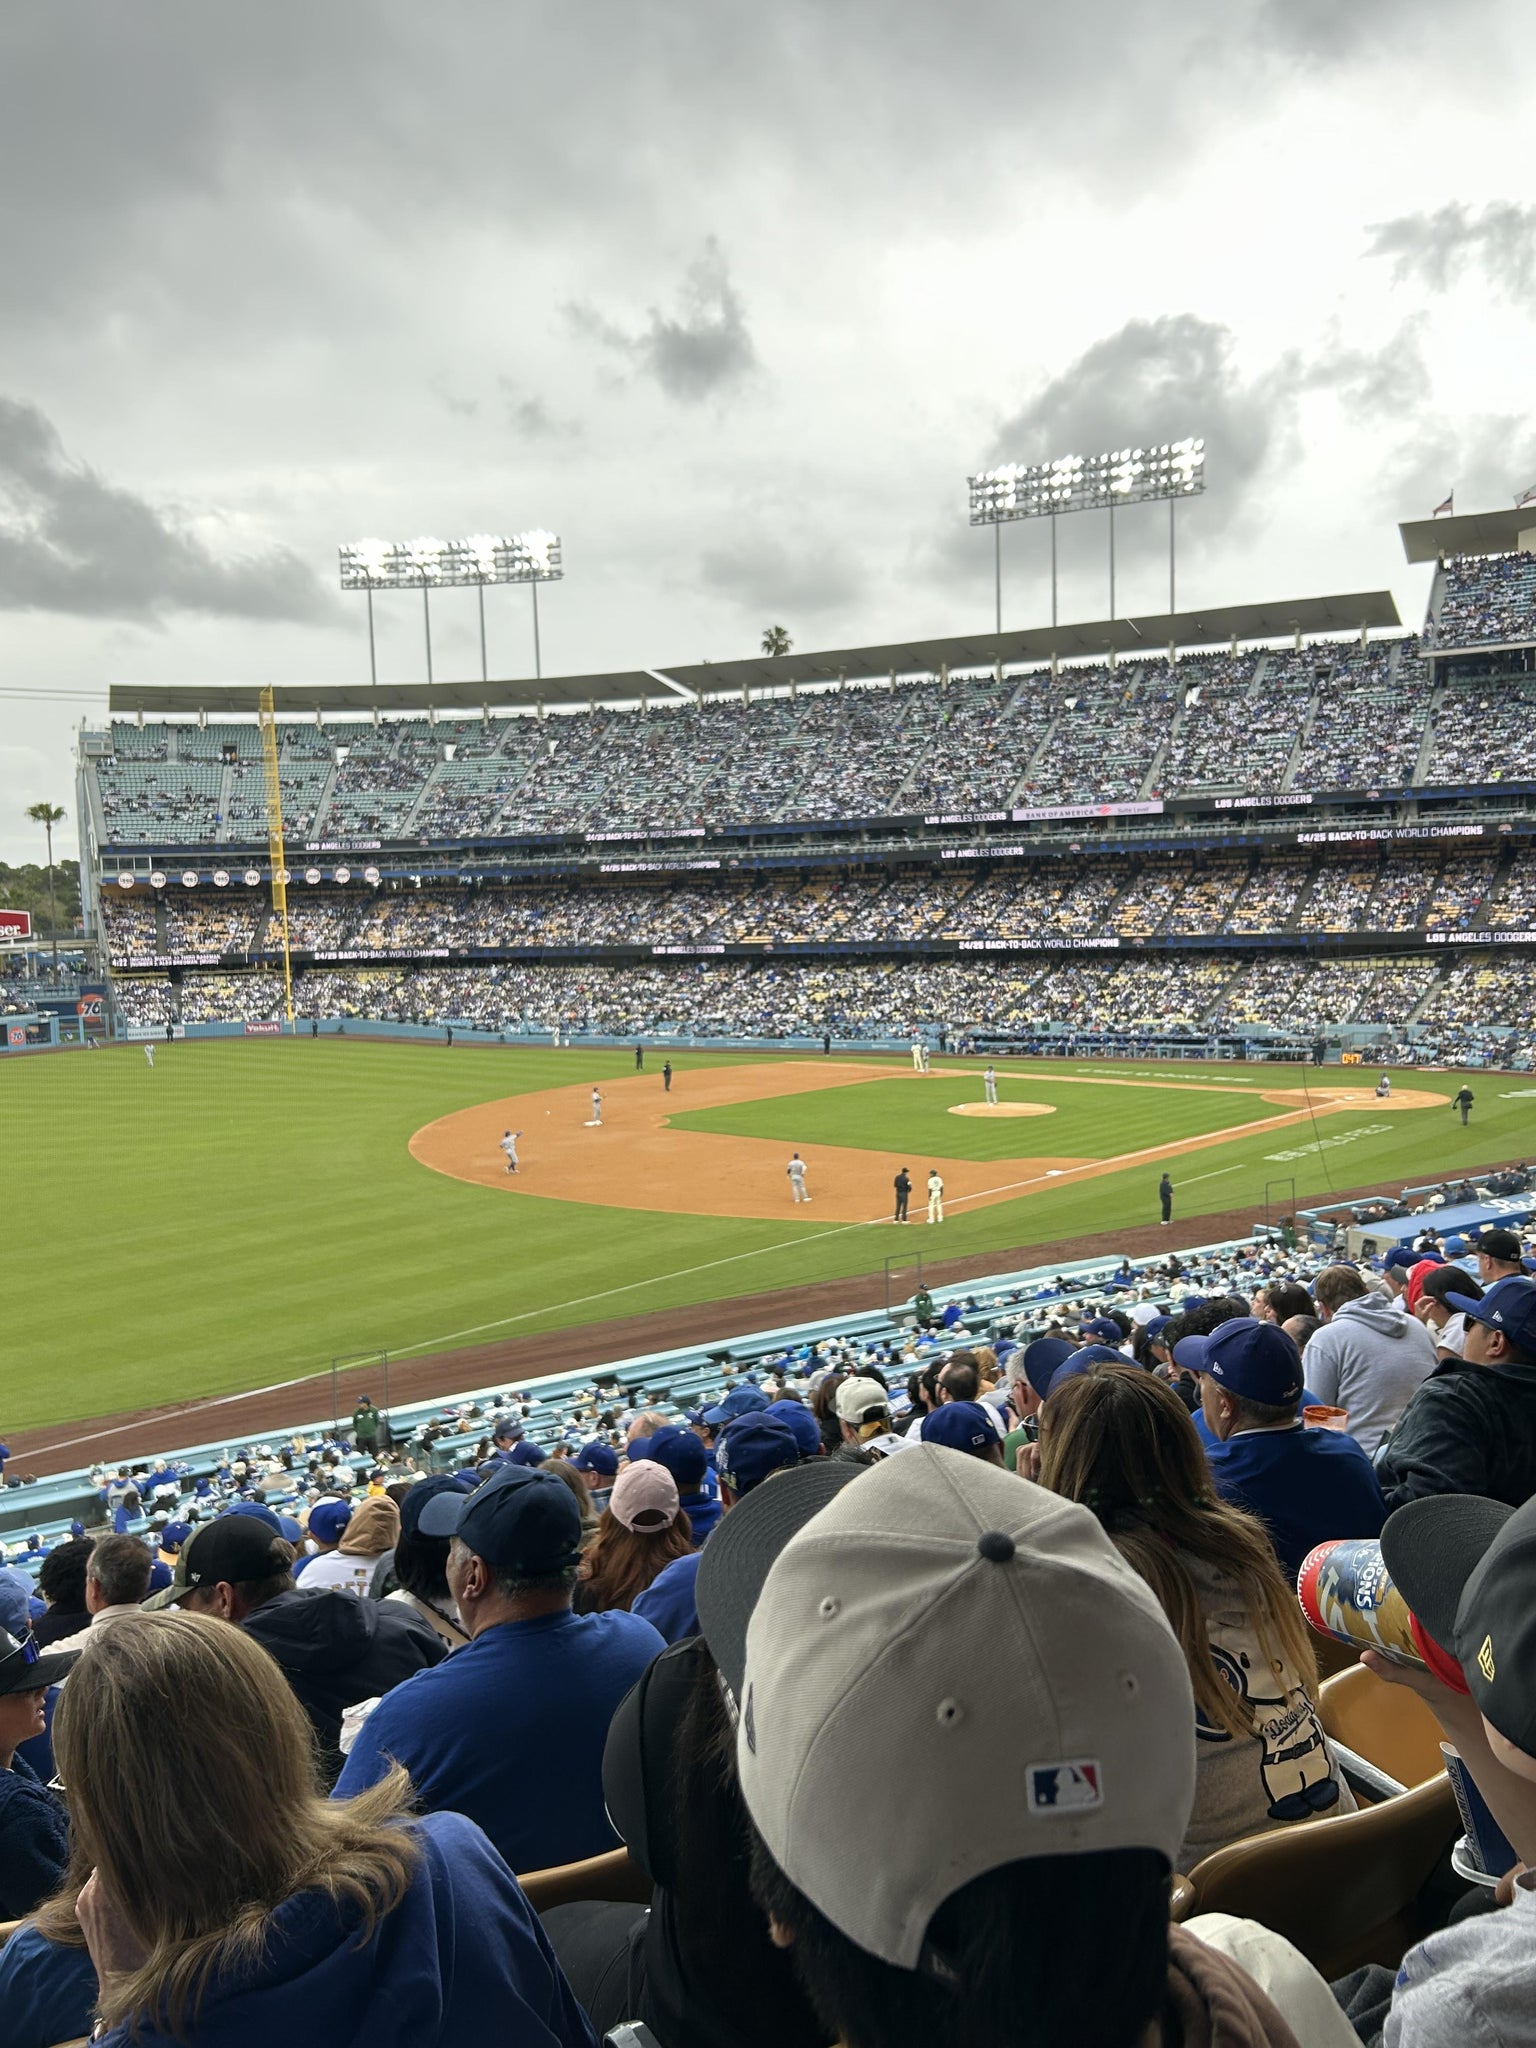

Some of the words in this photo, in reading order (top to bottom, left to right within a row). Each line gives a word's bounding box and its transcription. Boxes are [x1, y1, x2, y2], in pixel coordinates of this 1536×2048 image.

[1215, 799, 1232, 808] LOS
[1234, 797, 1272, 808] ANGELES
[1273, 794, 1312, 805] DODGERS
[1060, 809, 1094, 817] AMERICA
[924, 816, 940, 825] LOS
[941, 814, 973, 824] ANGELES
[1297, 833, 1326, 843] 24/25
[1328, 829, 1393, 841] BACK-TO-BACK
[1395, 827, 1429, 838] WORLD
[1430, 825, 1483, 836] CHAMPIONS
[941, 850, 956, 858] LOS
[957, 848, 990, 857] ANGELES
[1426, 933, 1446, 942] LOS
[1448, 932, 1492, 942] ANGELES
[959, 941, 984, 949] 24/25
[985, 939, 1041, 949] BACK-TO-BACK
[1043, 939, 1071, 948] WORLD
[1073, 938, 1119, 947] CHAMPIONS
[413, 948, 449, 957] CHAMPIONS
[82, 999, 102, 1017] 76
